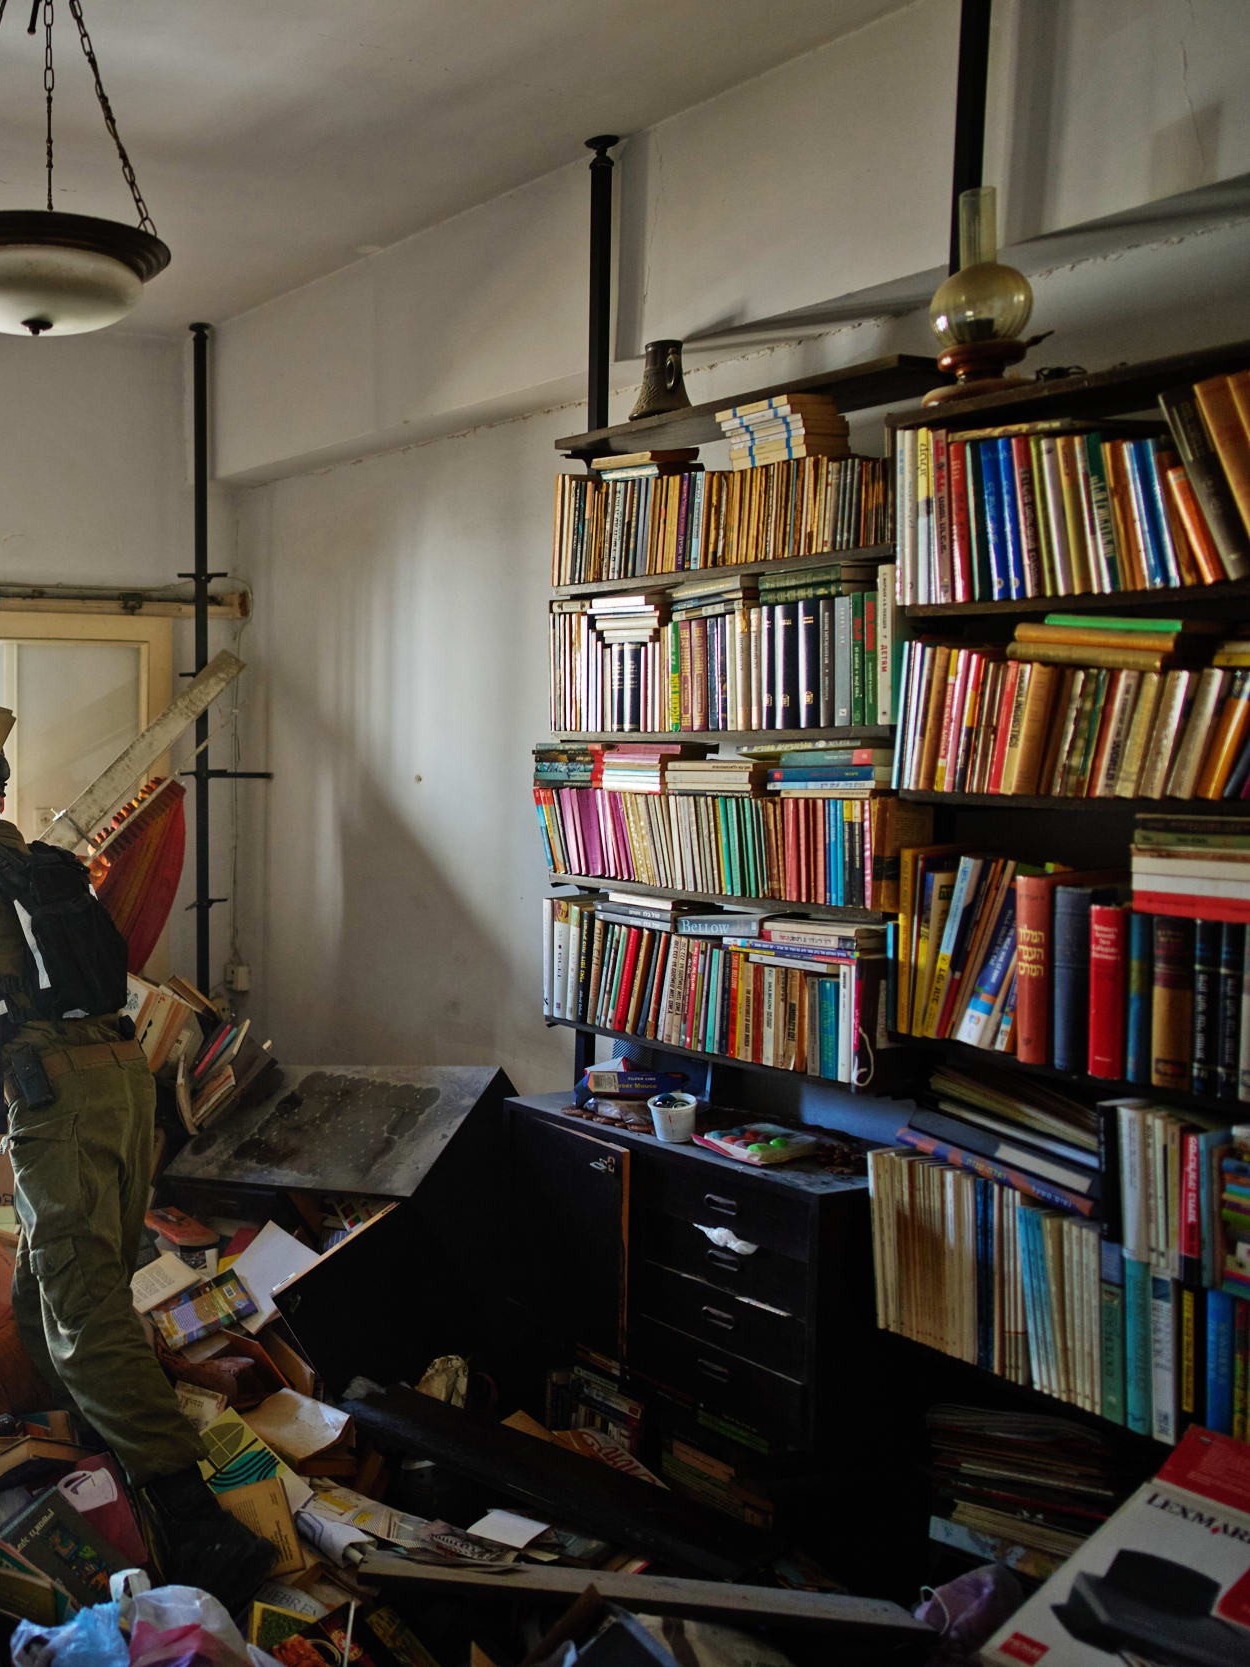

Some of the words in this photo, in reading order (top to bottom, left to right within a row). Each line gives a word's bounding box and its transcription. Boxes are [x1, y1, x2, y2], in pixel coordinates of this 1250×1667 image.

[880, 644, 888, 673] ДЕТЯМ
[937, 966, 945, 983] דפי
[931, 985, 942, 1005] זהב
[1184, 1136, 1198, 1189] פסיכולוגיה
[1184, 1191, 1198, 1224] בחינוך
